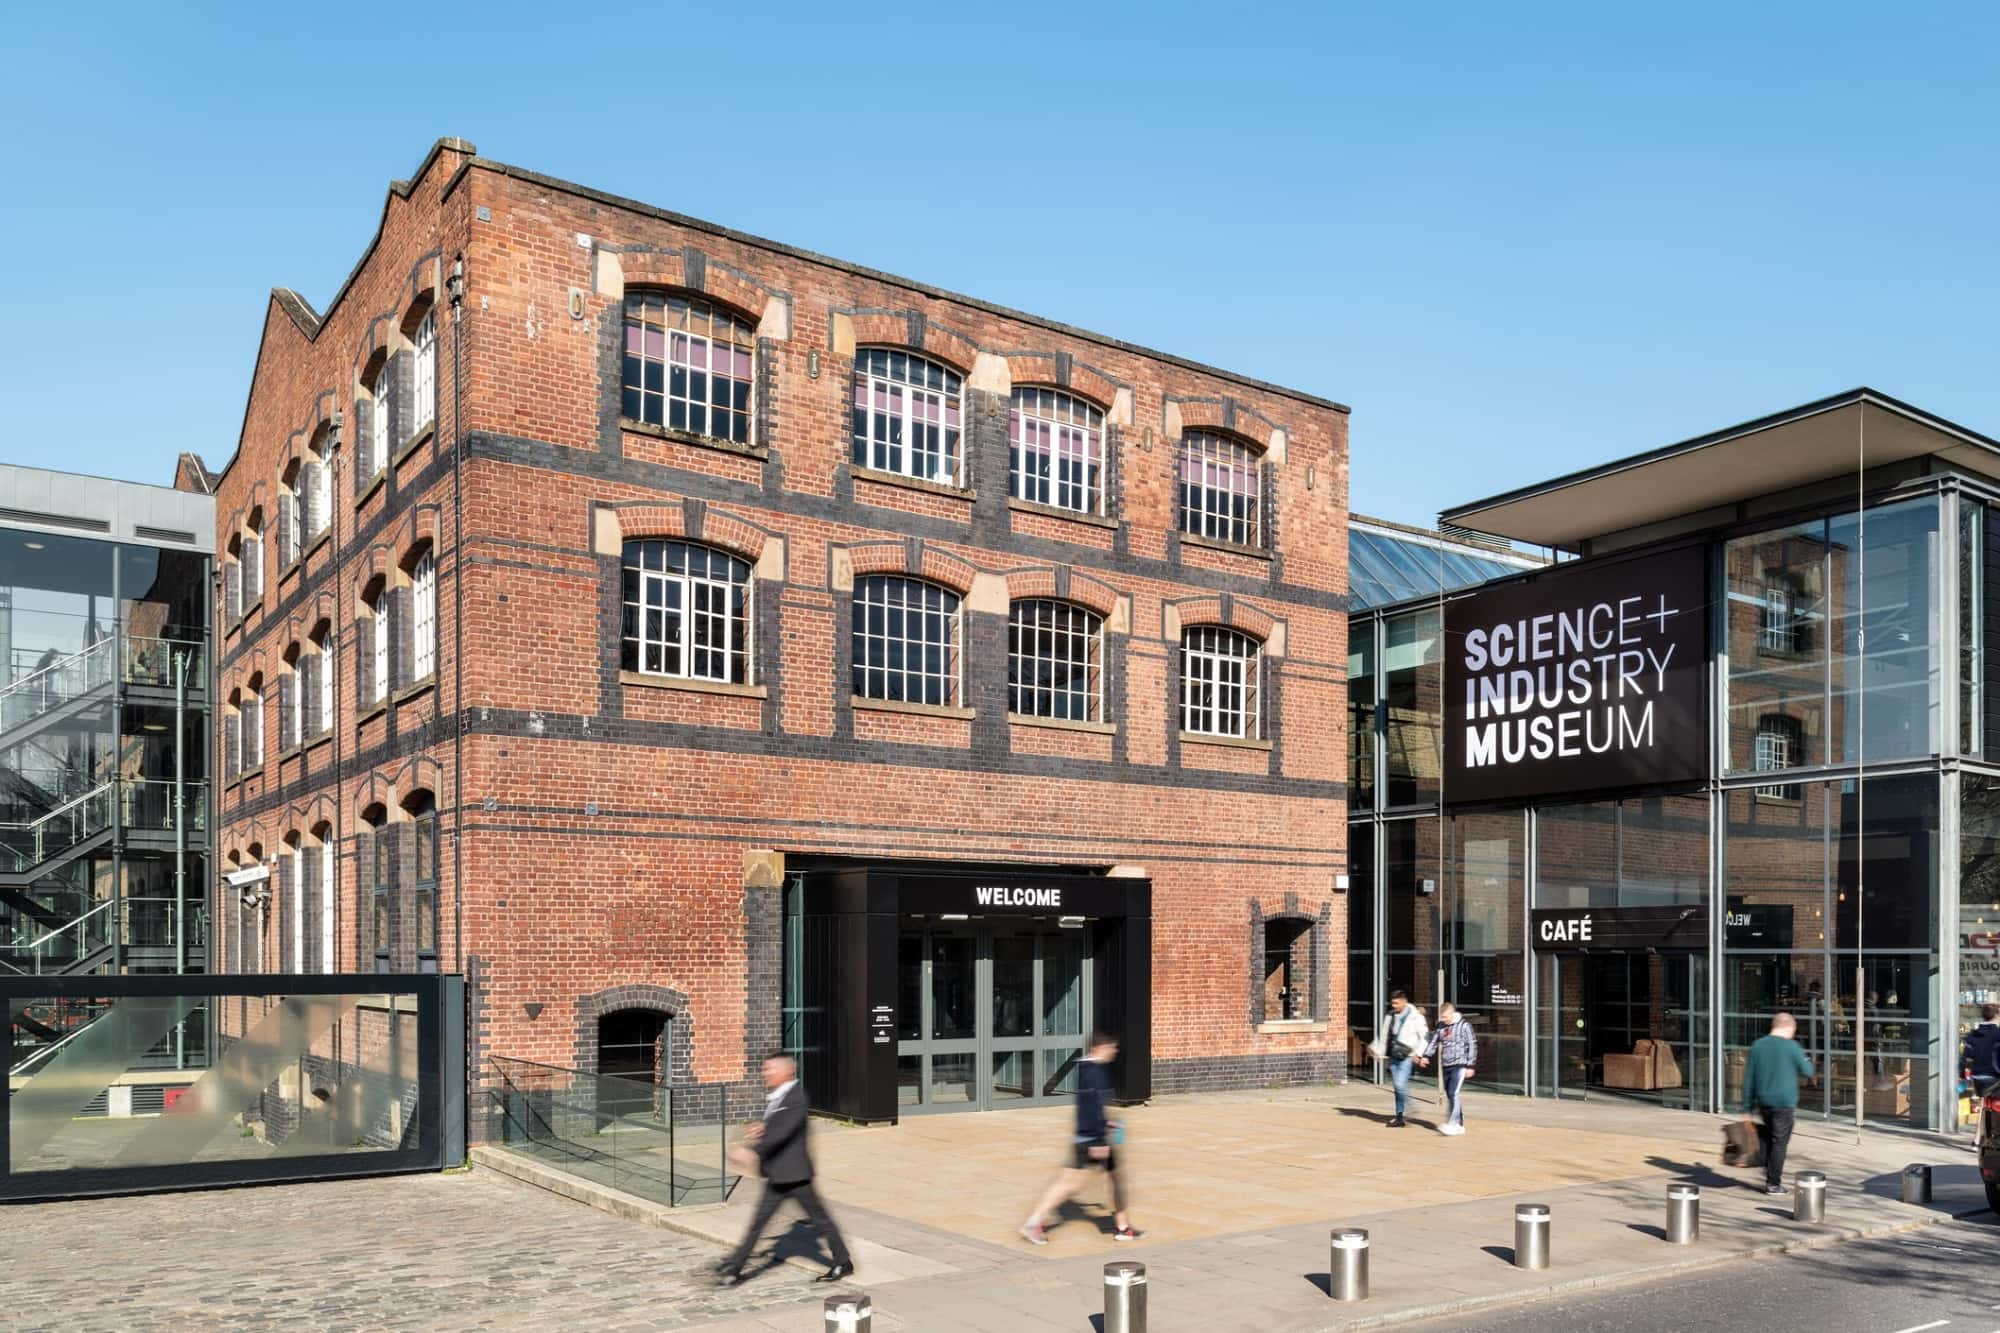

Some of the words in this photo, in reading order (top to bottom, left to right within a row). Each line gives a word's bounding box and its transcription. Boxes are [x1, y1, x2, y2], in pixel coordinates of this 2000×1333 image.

[1465, 643, 1676, 720] INDUSTRY
[1465, 701, 1654, 768] MUSEUM
[976, 887, 1061, 906] WELCOME
[1540, 914, 1592, 942] CAFÉ
